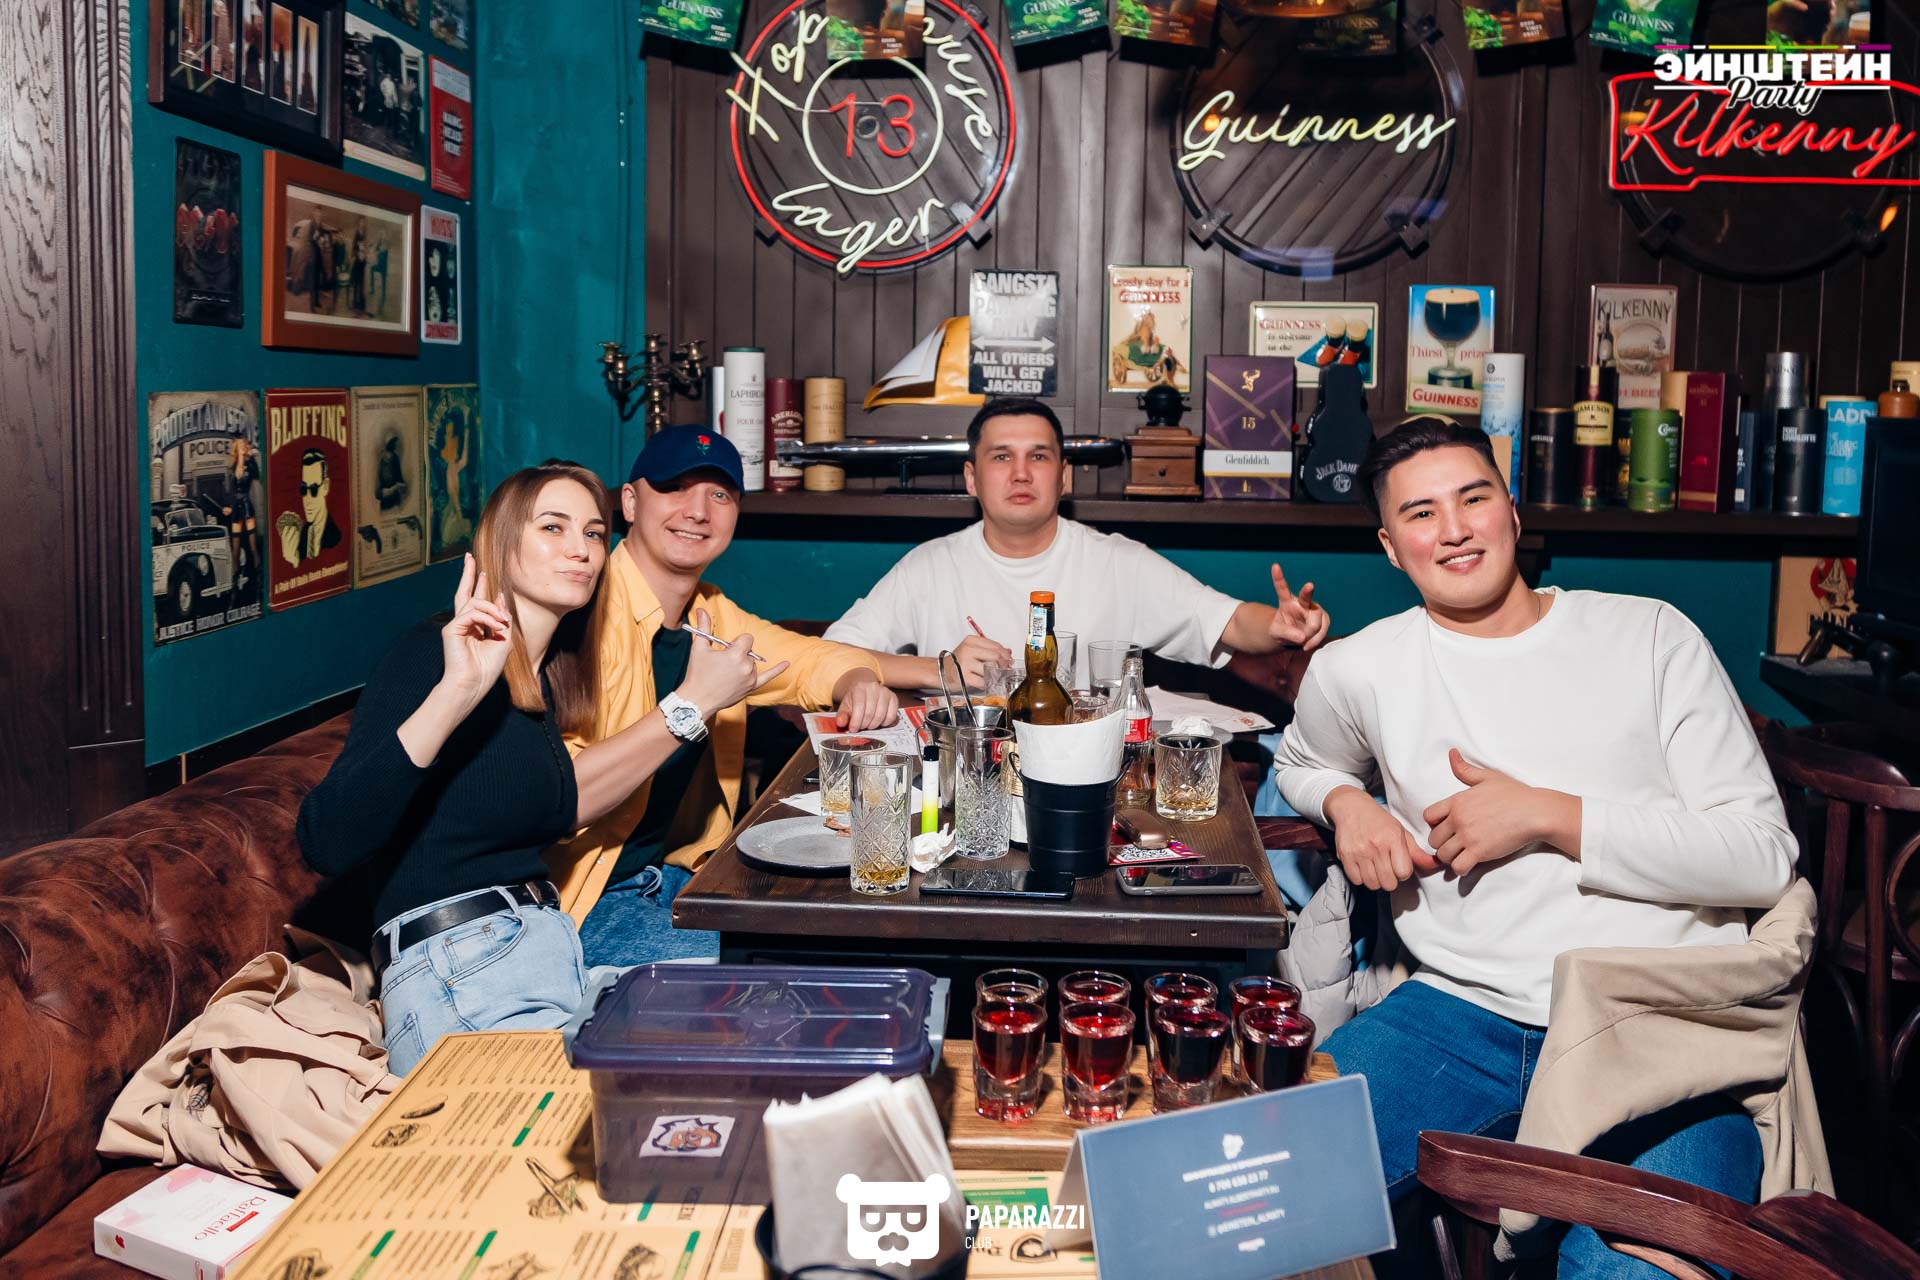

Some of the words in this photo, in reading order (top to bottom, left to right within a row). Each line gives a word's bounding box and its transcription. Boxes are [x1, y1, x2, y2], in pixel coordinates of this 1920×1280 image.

[1612, 9, 1676, 32] GUINNESS
[829, 93, 915, 158] 13
[1178, 90, 1456, 171] Guinness
[1620, 91, 1917, 178] Kilkenny
[772, 182, 945, 273] Lager
[972, 271, 1058, 296] GANGSTA
[1120, 290, 1181, 304] GUINNESS
[1597, 299, 1672, 324] KILKENNY
[1258, 319, 1321, 330] GUINNESS
[973, 351, 998, 364] ALL
[1001, 352, 1055, 366] OTHERS
[1410, 345, 1443, 359] Thirst
[982, 365, 1015, 379] WILL
[1019, 367, 1046, 380] GET
[983, 379, 1043, 393] JACKED
[1412, 388, 1479, 409] GUINNESS
[1576, 404, 1610, 416] JAMESON
[1828, 407, 1877, 425] LADD
[271, 405, 347, 456] BLUFFING
[1241, 416, 1256, 430] 15
[190, 441, 231, 458] POLICE
[1225, 454, 1270, 466] Glenfiddich
[1316, 464, 1336, 480] JACK
[158, 621, 195, 641] JUSTICE
[194, 1196, 267, 1241] Raffaello
